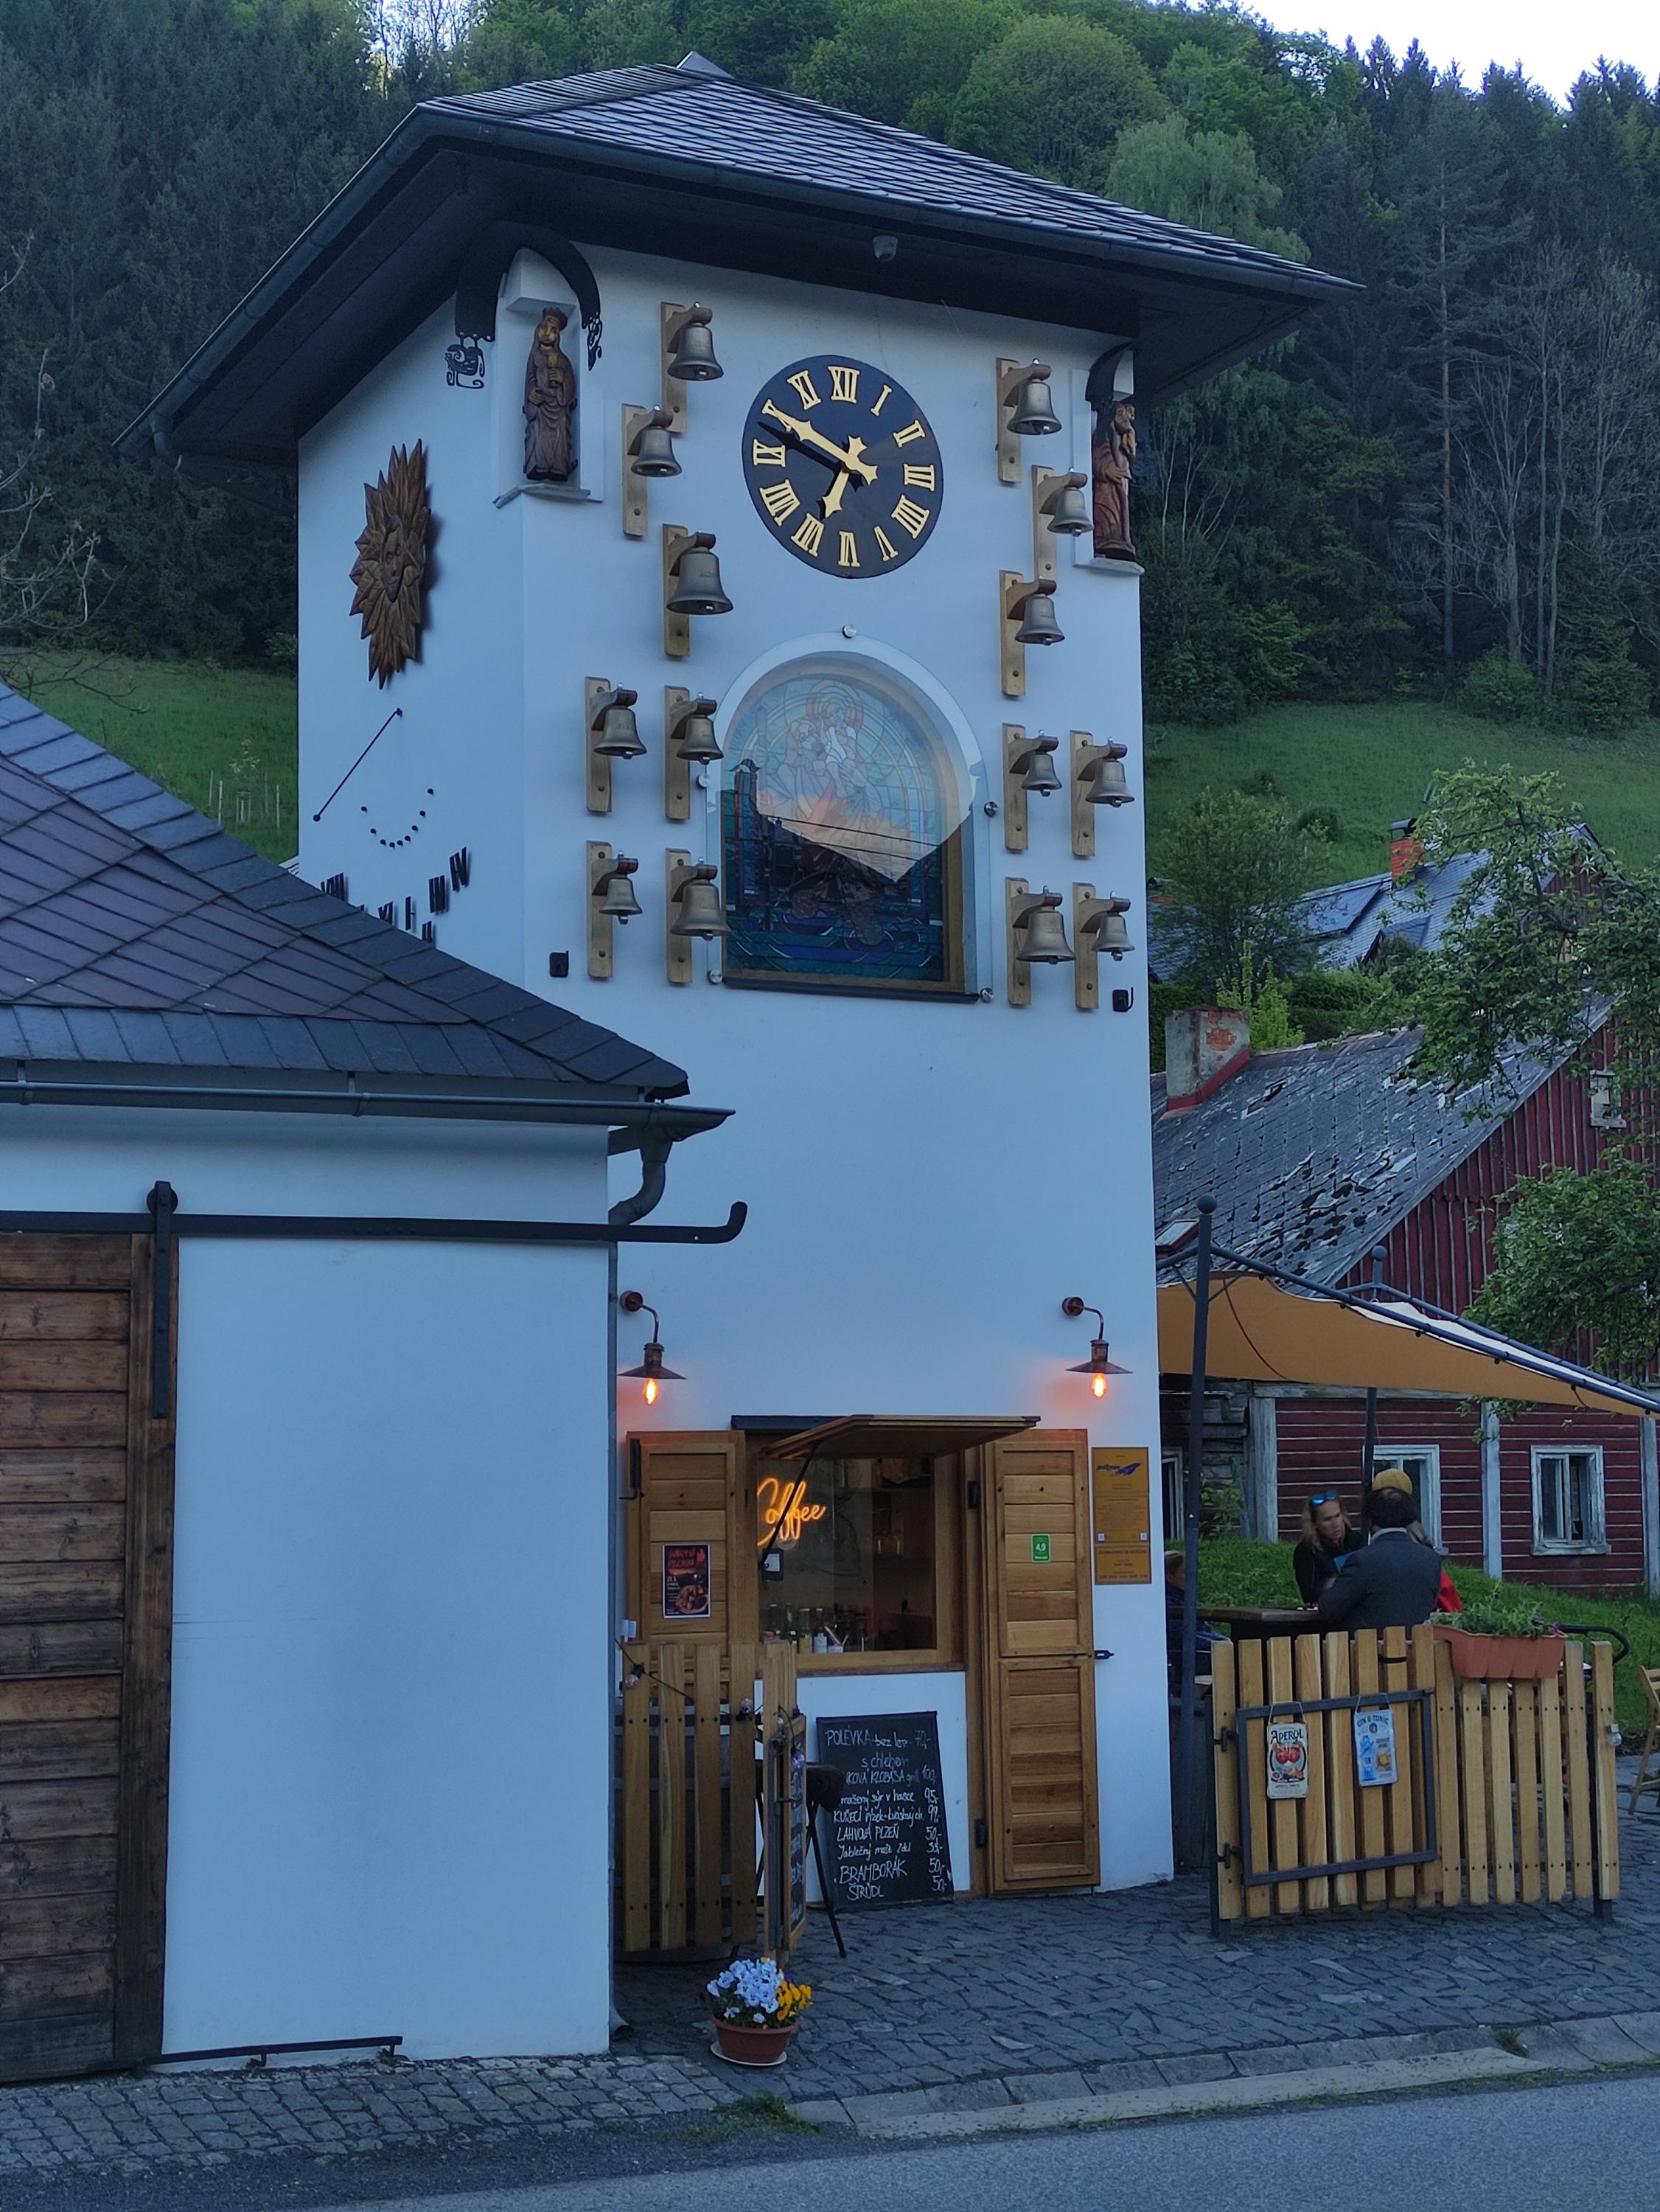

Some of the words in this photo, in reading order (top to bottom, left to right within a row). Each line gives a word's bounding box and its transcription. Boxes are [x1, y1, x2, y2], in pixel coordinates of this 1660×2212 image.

[787, 369, 822, 410] XI
[828, 366, 859, 403] XII
[871, 384, 892, 416] I
[893, 420, 926, 448] II
[753, 439, 787, 467] IX
[904, 463, 935, 492] III
[759, 479, 801, 526] VIII
[891, 494, 930, 540] IIII
[790, 512, 825, 557] VII
[838, 530, 860, 567] VI
[873, 525, 899, 561] V
[756, 1477, 826, 1546] Coffee
[825, 1725, 872, 1747] POLÉVKA
[1270, 1728, 1304, 1745] APEROL
[1372, 1714, 1389, 1725] TONIC
[839, 1855, 908, 1885] BRAMBORÁK
